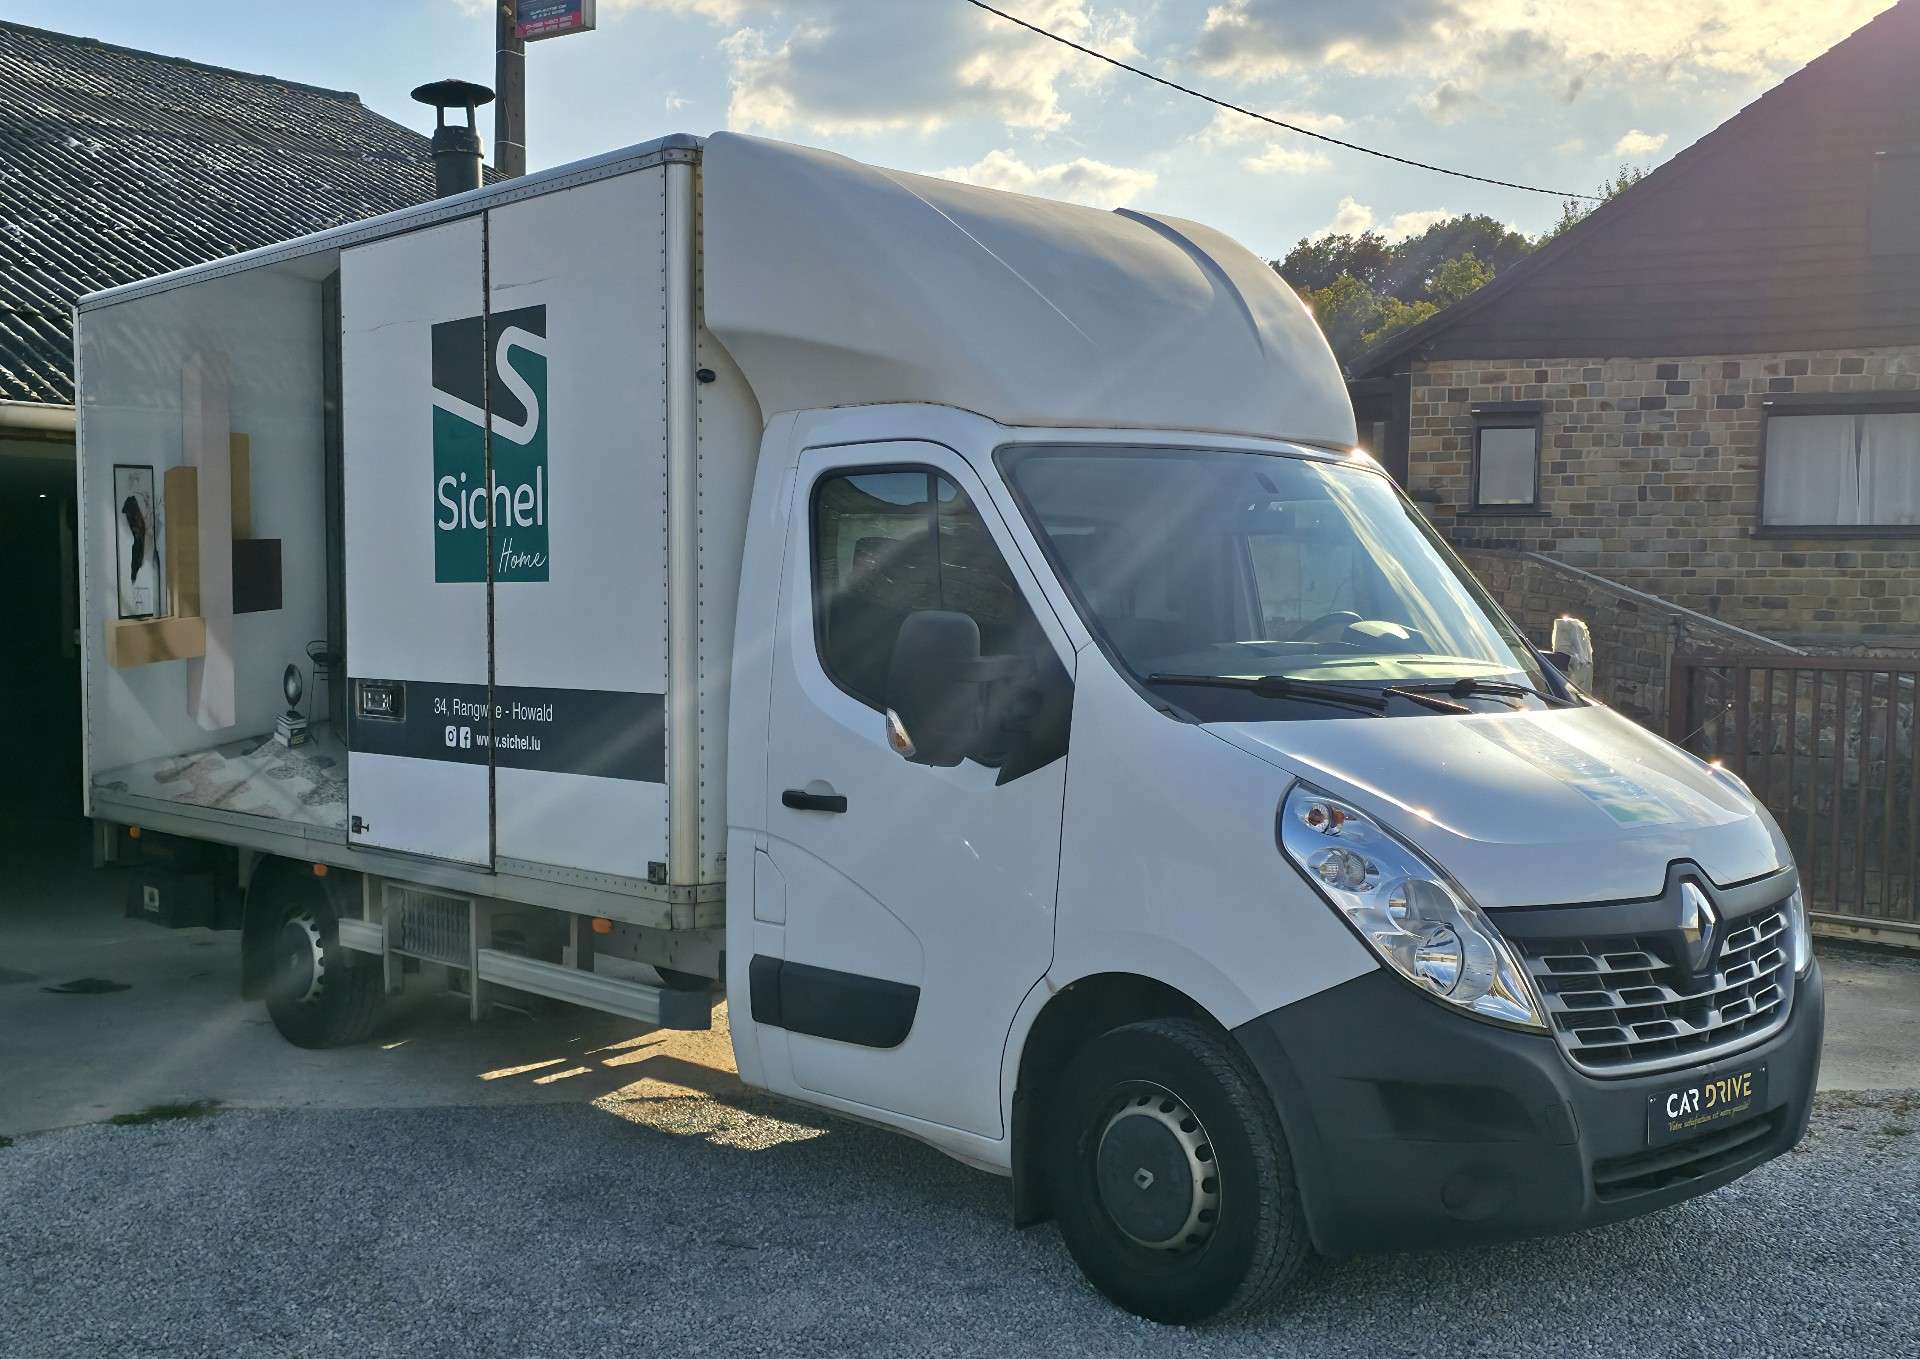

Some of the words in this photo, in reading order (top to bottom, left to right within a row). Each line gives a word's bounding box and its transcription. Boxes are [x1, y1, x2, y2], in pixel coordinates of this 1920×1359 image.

[438, 465, 543, 530] Sichel
[498, 537, 547, 573] Home
[434, 697, 450, 717] 34,
[453, 698, 502, 721] Rangwe
[512, 702, 553, 722] Howald
[1666, 1088, 1700, 1118] CAR
[1705, 1072, 1752, 1108] DRIVE
